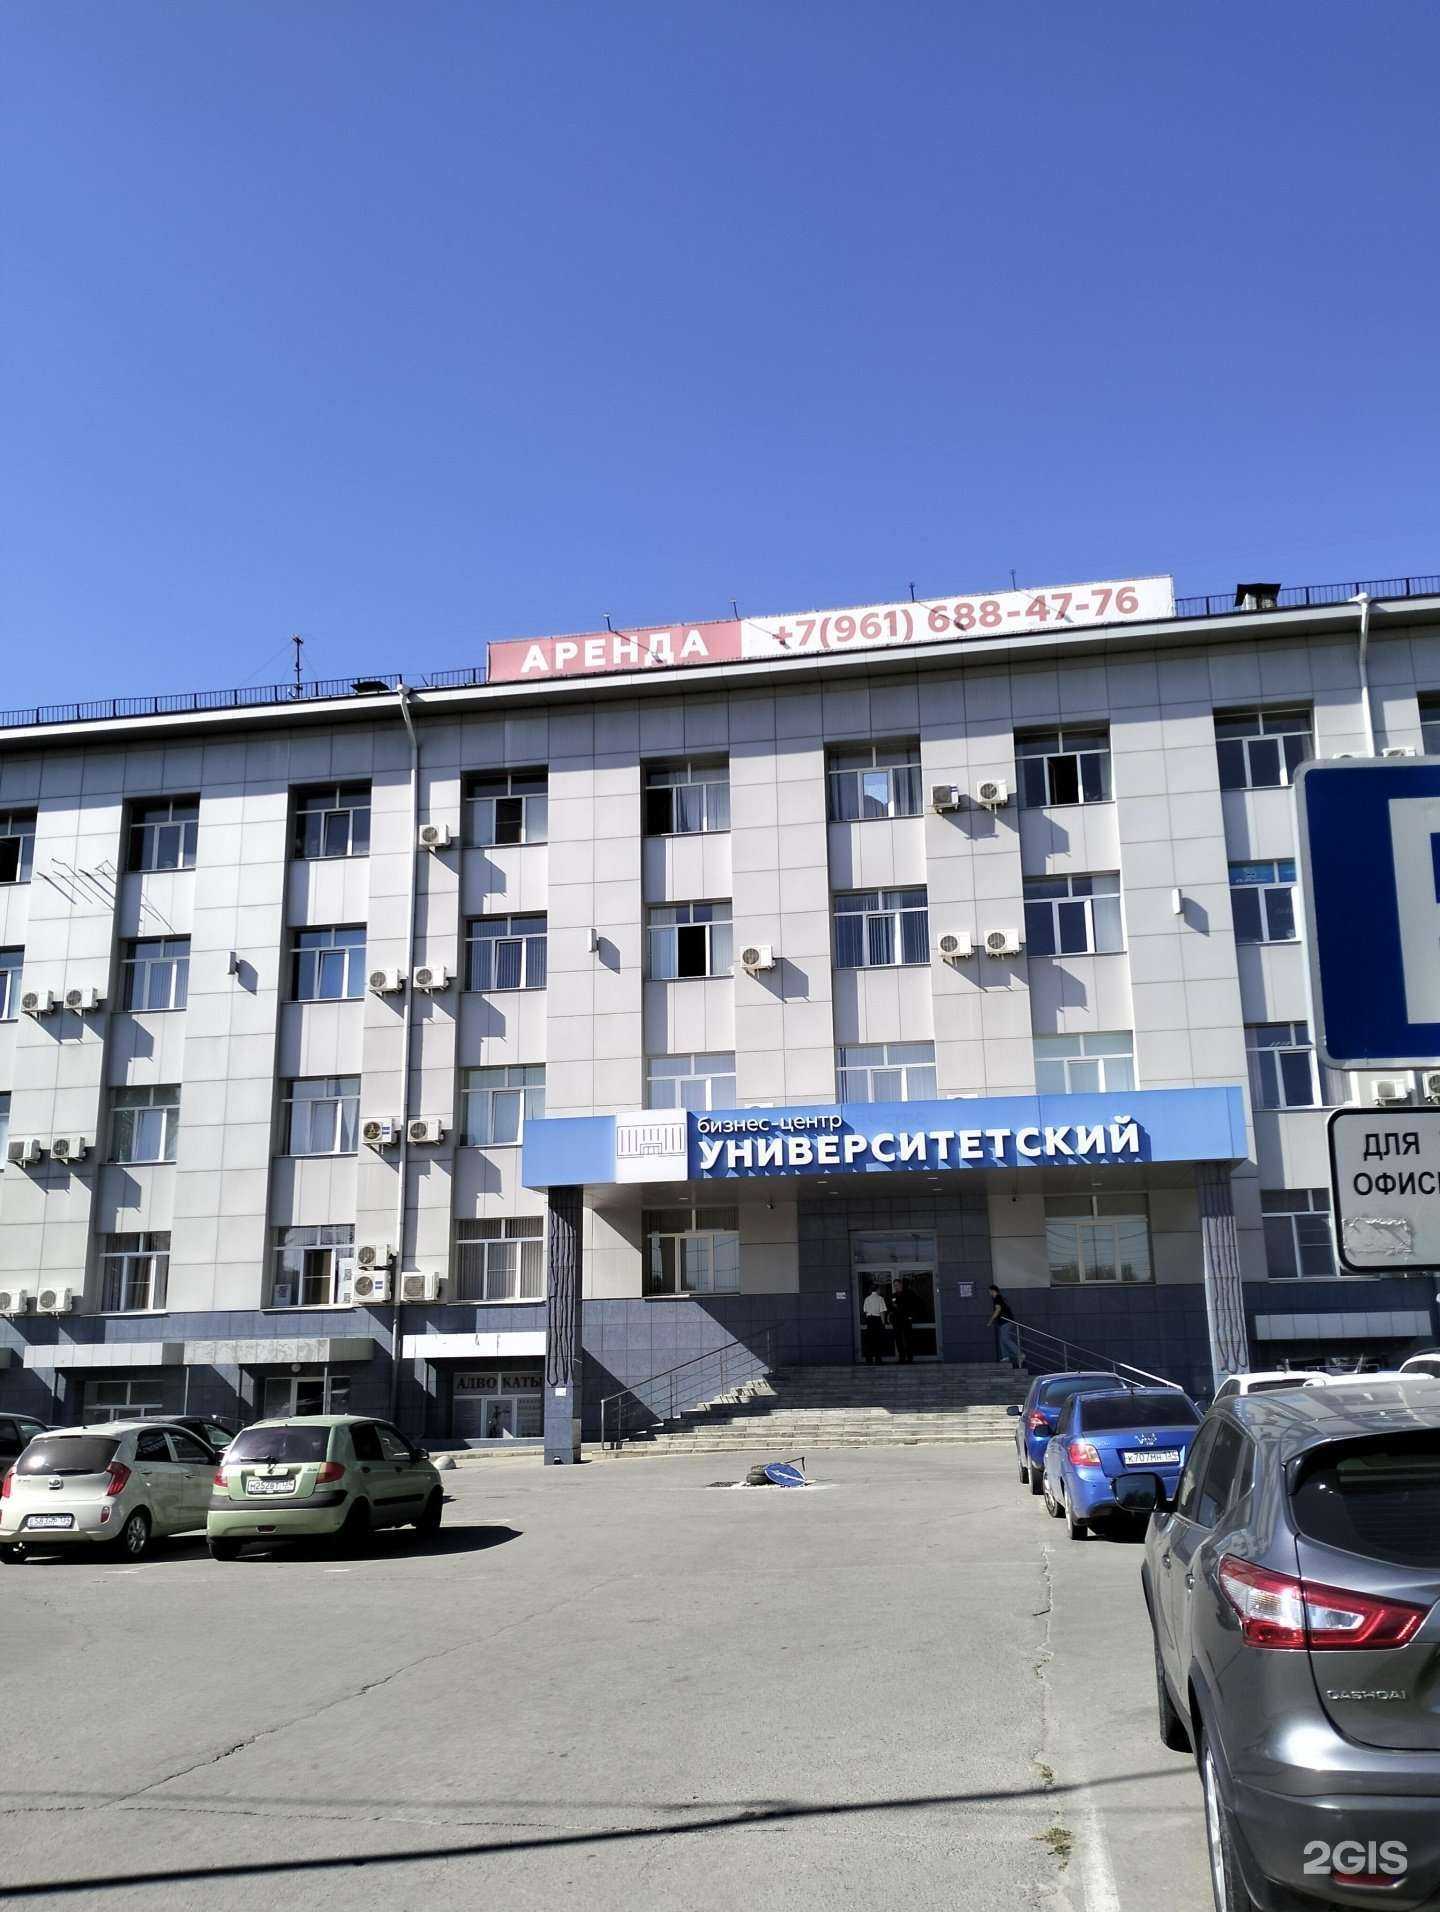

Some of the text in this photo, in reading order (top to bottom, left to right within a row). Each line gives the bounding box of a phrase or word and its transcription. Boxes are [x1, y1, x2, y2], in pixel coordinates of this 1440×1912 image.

[520, 586, 1140, 673] АРЕНДА +7(961) 688-47-76
[697, 1114, 842, 1134] бизнес-центр
[697, 1115, 1140, 1170] УНИВЕРСИТЕТСКИЙ
[1363, 1132, 1421, 1162] ДЛЯ
[1353, 1171, 1440, 1196] ОФИС
